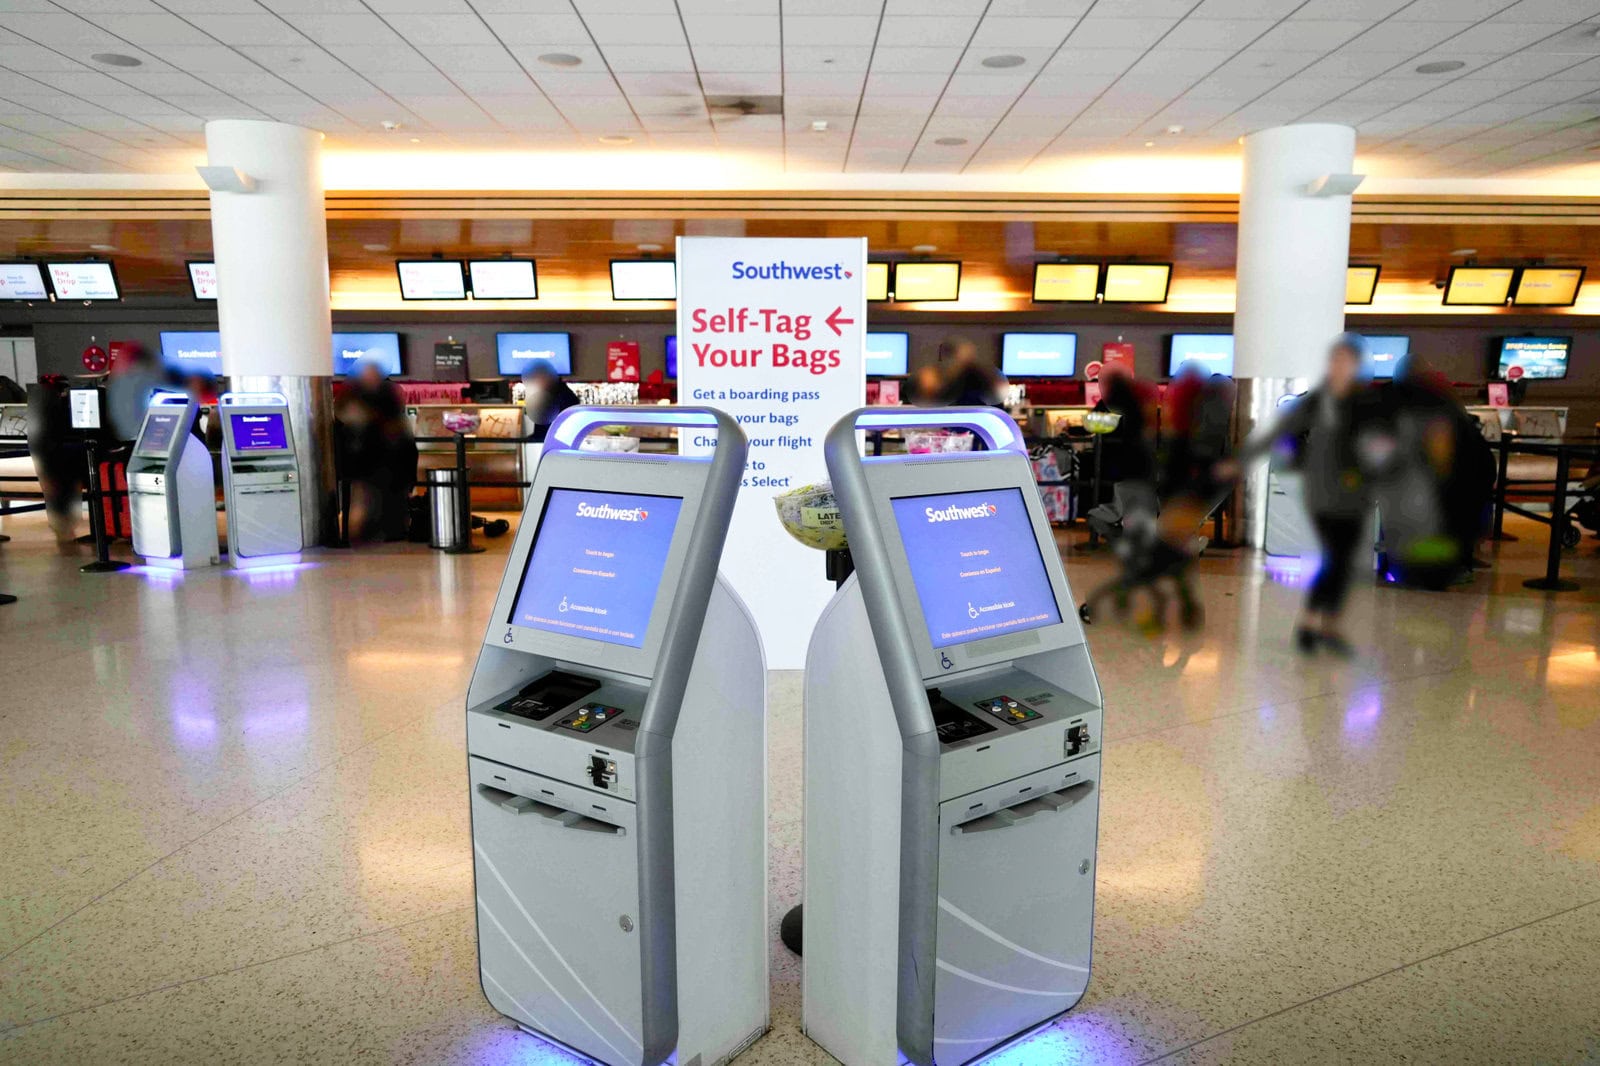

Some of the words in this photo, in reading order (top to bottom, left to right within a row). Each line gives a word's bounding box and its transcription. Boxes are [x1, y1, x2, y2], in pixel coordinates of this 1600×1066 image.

[54, 270, 69, 278] Bag
[732, 261, 842, 279] Southwest
[57, 278, 76, 286] Drop
[692, 307, 812, 341] Self-Tag
[178, 350, 217, 358] Southwest
[692, 343, 763, 367] Your
[772, 343, 841, 375] Bags
[693, 388, 715, 400] Get
[718, 391, 726, 400] a
[730, 388, 789, 402] boarding
[792, 391, 820, 402] pass
[770, 412, 799, 426] bags
[778, 436, 812, 450] flight
[752, 461, 766, 470] to
[752, 476, 789, 487] Select
[576, 502, 640, 522] Southwest
[926, 504, 990, 522] Southwest
